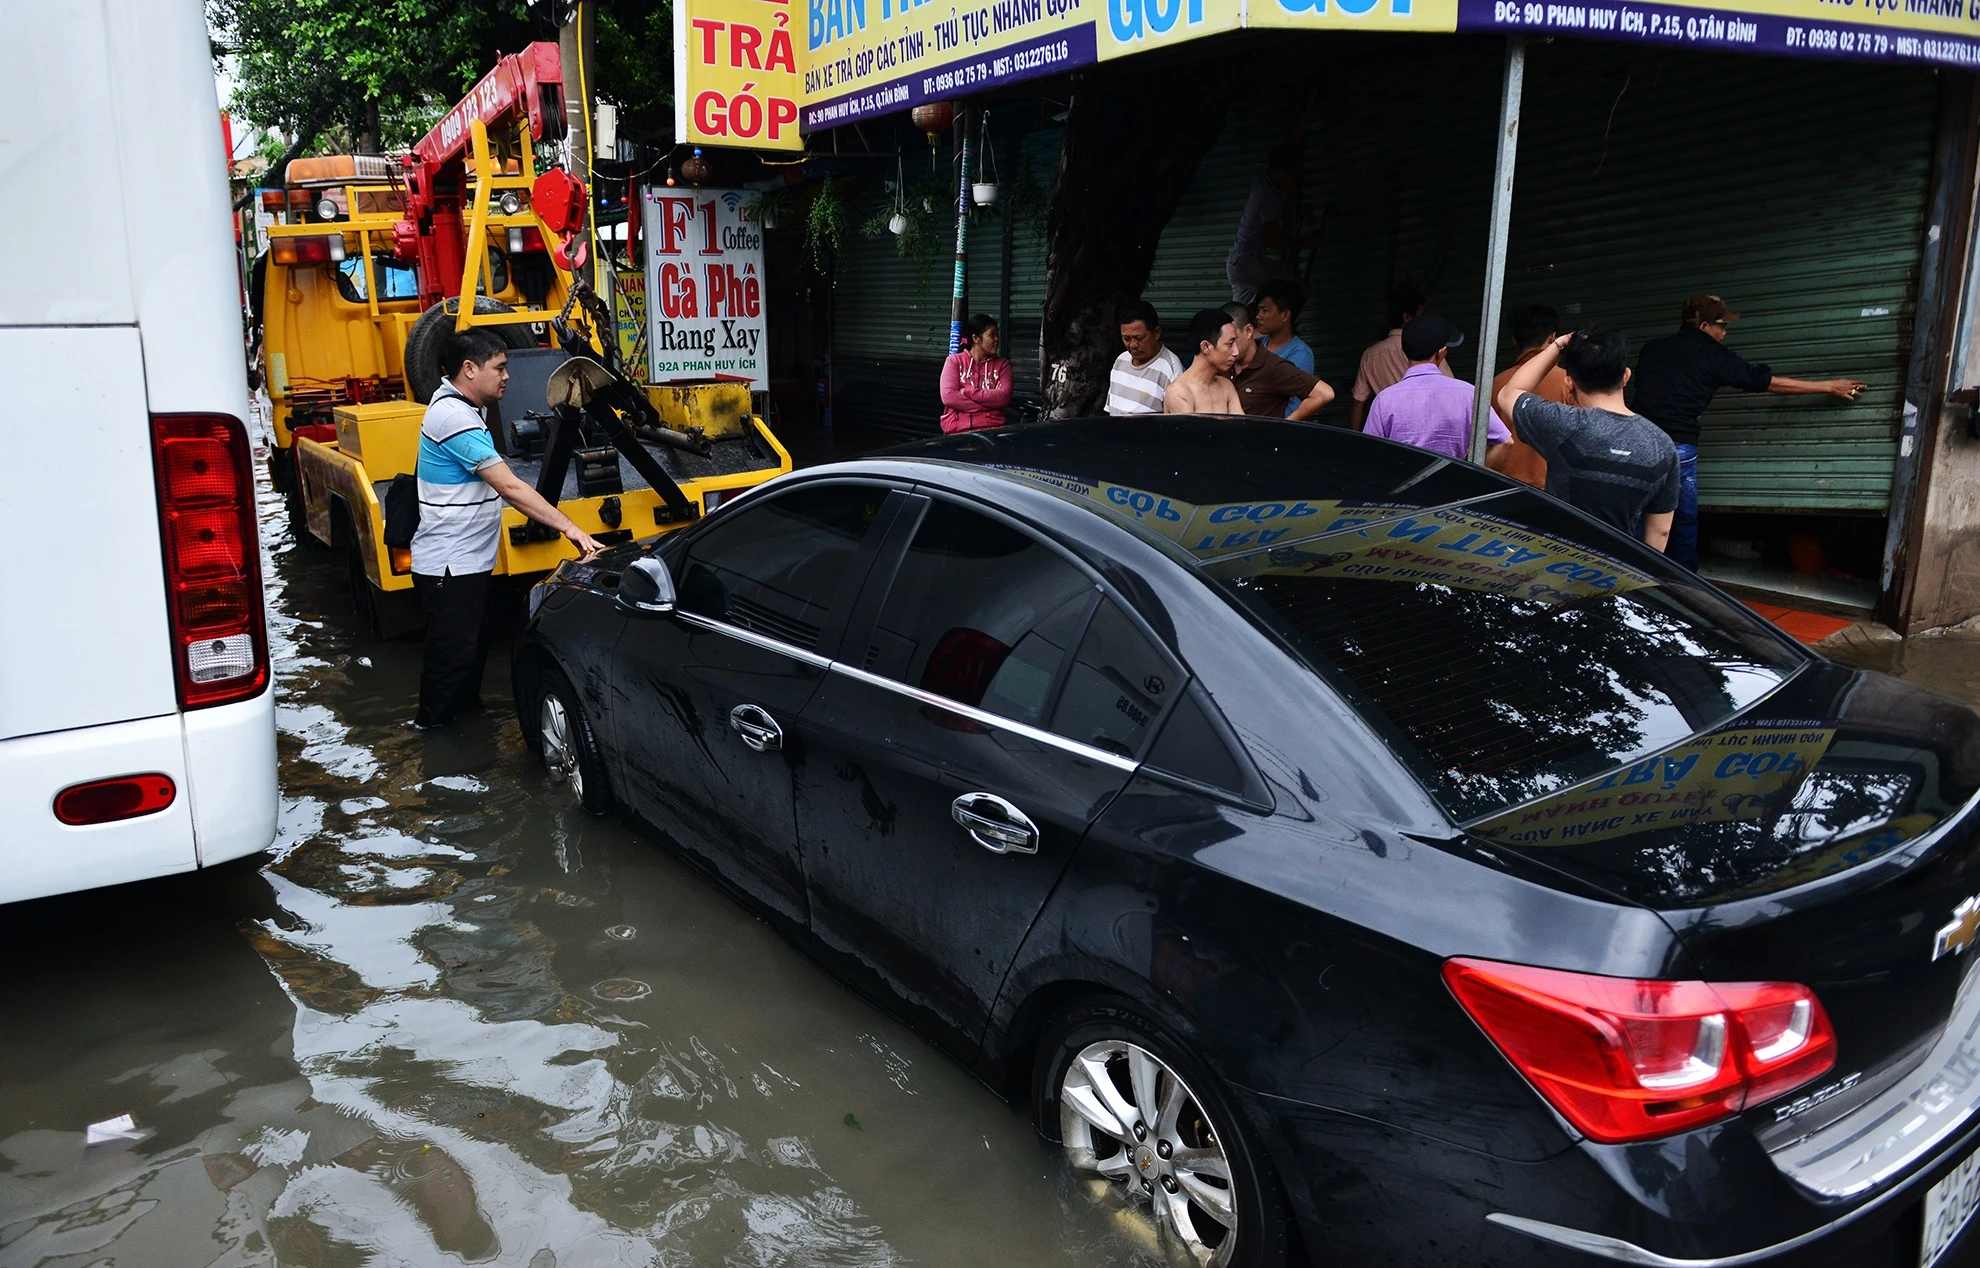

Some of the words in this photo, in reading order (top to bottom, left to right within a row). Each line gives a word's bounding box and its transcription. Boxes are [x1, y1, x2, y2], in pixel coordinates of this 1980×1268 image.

[692, 11, 797, 75] TRẢ
[1494, 1, 1521, 24] ĐC:
[1523, 3, 1544, 26] 90
[1547, 4, 1586, 28] PHAN
[1589, 7, 1618, 31] HUY
[1620, 7, 1648, 37] ÍCH,
[1650, 13, 1683, 40] P.15,
[1686, 14, 1724, 42] Q.TÂN
[1727, 17, 1758, 43] BÌNH
[1786, 26, 1806, 47] ĐT:
[1808, 29, 1838, 50] 0936
[1839, 31, 1854, 52] 02
[1857, 33, 1872, 53] 75
[1874, 34, 1888, 54] 79
[1896, 36, 1922, 57] MST:
[805, 64, 821, 95] BÁN
[822, 64, 834, 87] XE
[835, 47, 853, 85] TRẢ
[855, 44, 874, 78] GÓP
[876, 36, 896, 71] CÁC
[899, 25, 924, 64] TỈNH
[934, 7, 958, 52] THỦ
[962, 7, 989, 46] TỤC
[923, 78, 935, 95] ĐT:
[936, 71, 953, 92] 0936
[954, 69, 965, 87] 02
[965, 66, 976, 84] 75
[976, 63, 988, 81] 79
[993, 56, 1013, 77] MST:
[1014, 39, 1069, 71] 0312276116
[440, 110, 462, 148] 0909
[461, 93, 479, 128] 123
[479, 75, 498, 112] 123
[693, 82, 799, 140] GÓP
[817, 110, 825, 124] 90
[825, 105, 838, 121] PHAN
[838, 103, 849, 119] HUY
[893, 84, 909, 102] BÌNH
[654, 196, 724, 257] F1
[723, 225, 760, 250] Coffee
[658, 262, 699, 319] Cà
[704, 262, 761, 319] Phê
[659, 320, 716, 358] Rang
[720, 319, 761, 356] Xay
[658, 361, 680, 372] 92A
[683, 360, 711, 371] PHAN
[715, 359, 735, 370] HUY
[739, 356, 756, 370] ÍCH
[1051, 363, 1067, 383] 76
